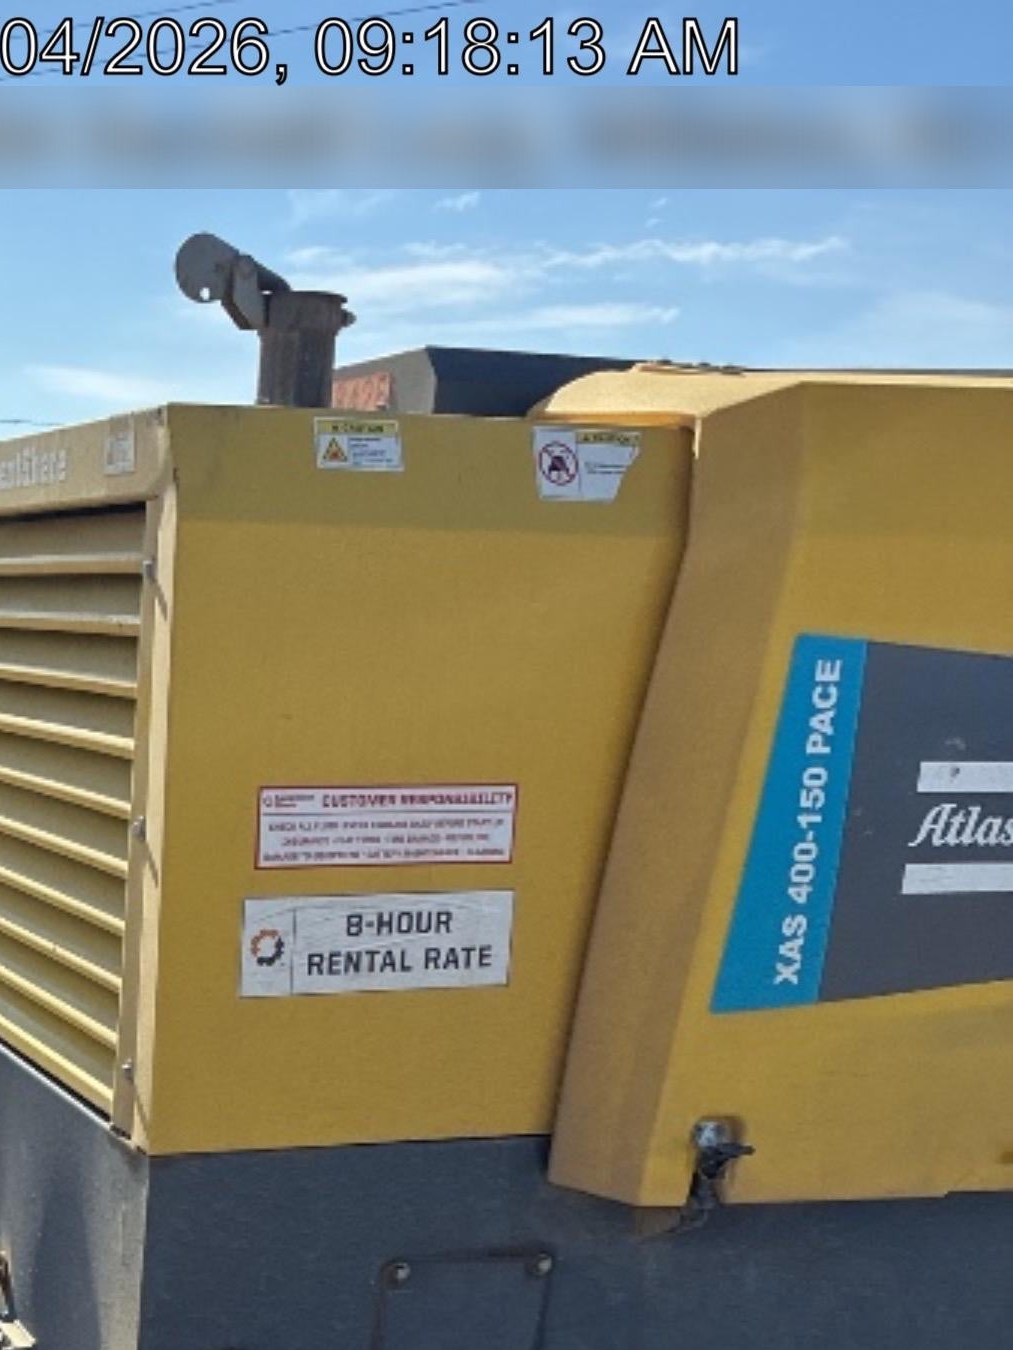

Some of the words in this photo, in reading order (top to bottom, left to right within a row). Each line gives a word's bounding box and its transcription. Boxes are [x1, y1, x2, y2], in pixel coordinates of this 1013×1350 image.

[805, 659, 842, 755] PACE
[787, 766, 828, 904] 400-150
[307, 951, 412, 976] RENTAL
[424, 945, 492, 970] RATE
[774, 914, 808, 985] XAS
